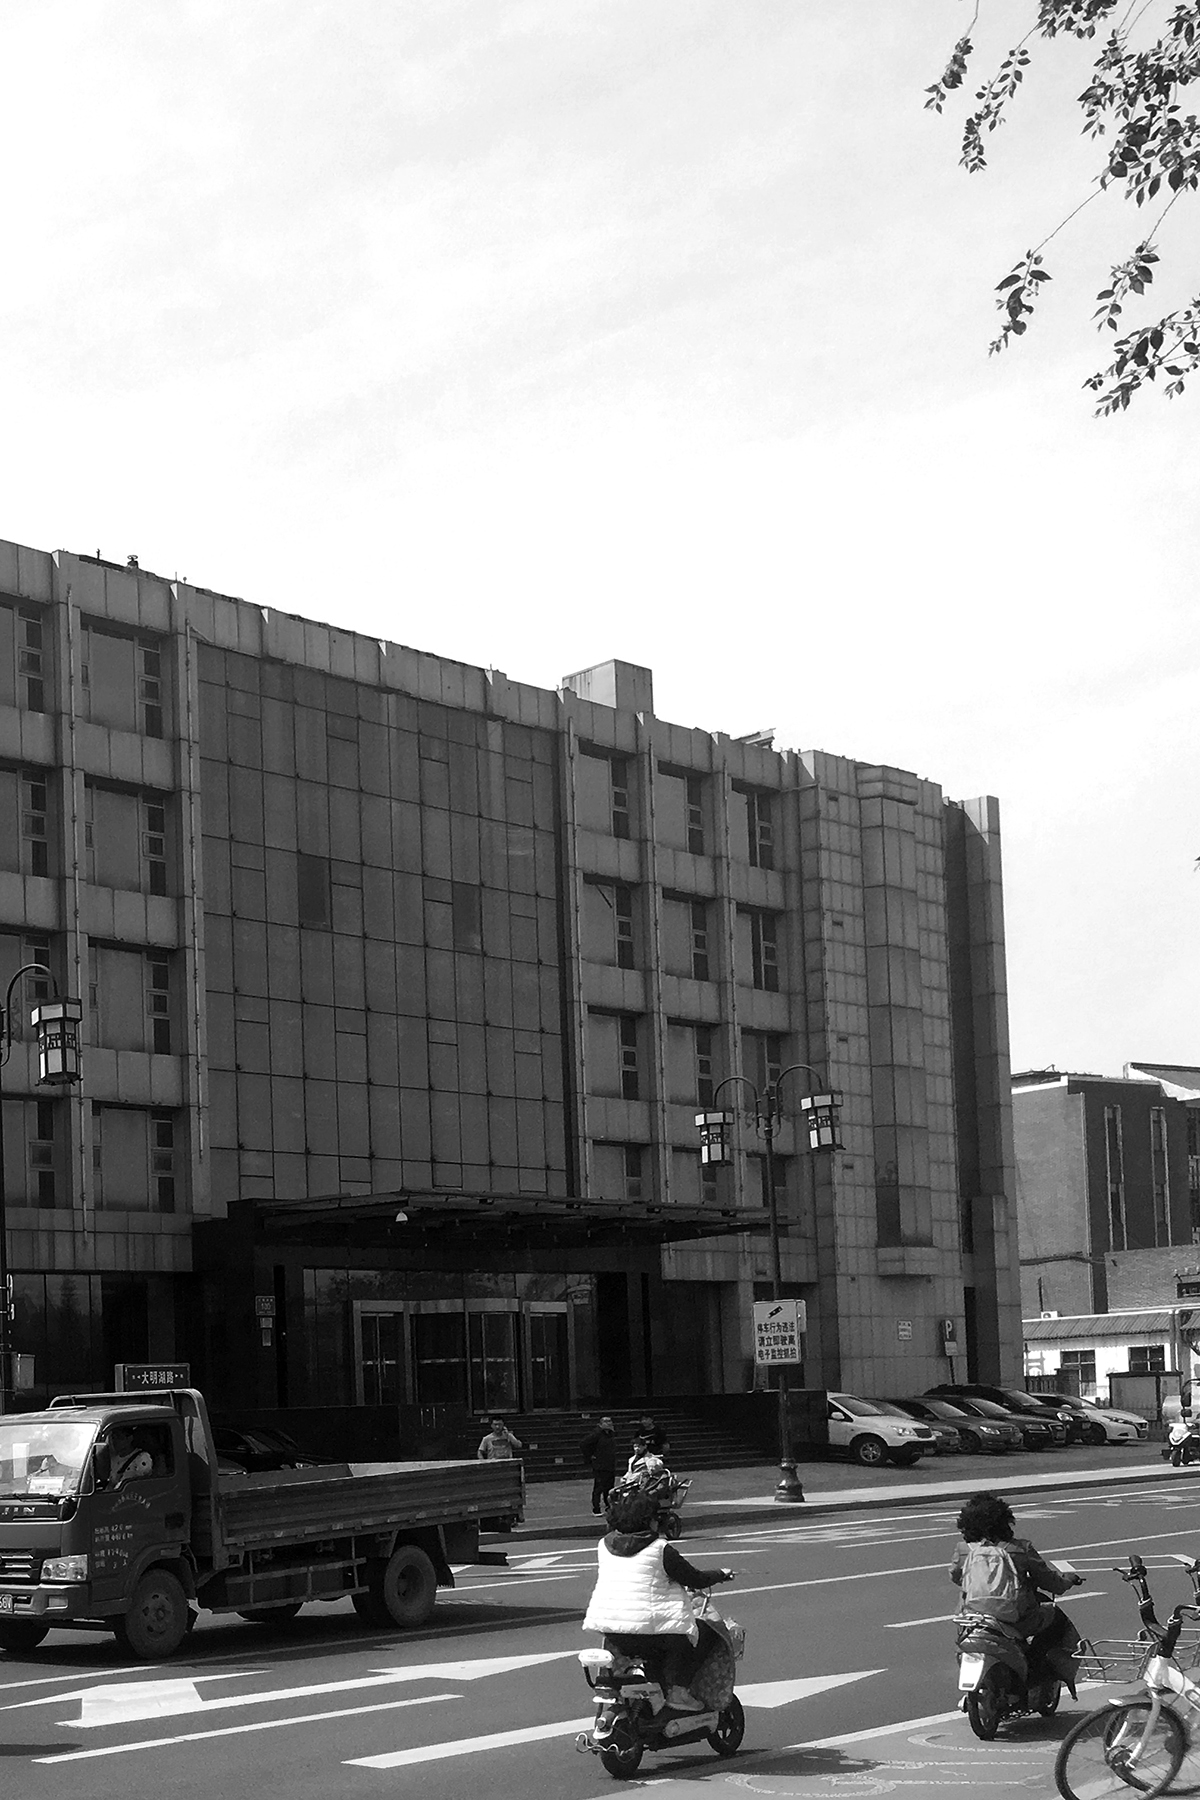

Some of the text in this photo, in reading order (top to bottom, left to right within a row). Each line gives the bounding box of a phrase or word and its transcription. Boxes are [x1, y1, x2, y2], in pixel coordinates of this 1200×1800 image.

[757, 1321, 795, 1334] 停车行为违法
[945, 1320, 953, 1339] P
[758, 1334, 796, 1347] 请立即驶离
[758, 1347, 797, 1360] 电子监控抓拍
[141, 1371, 174, 1384] 大明湖路
